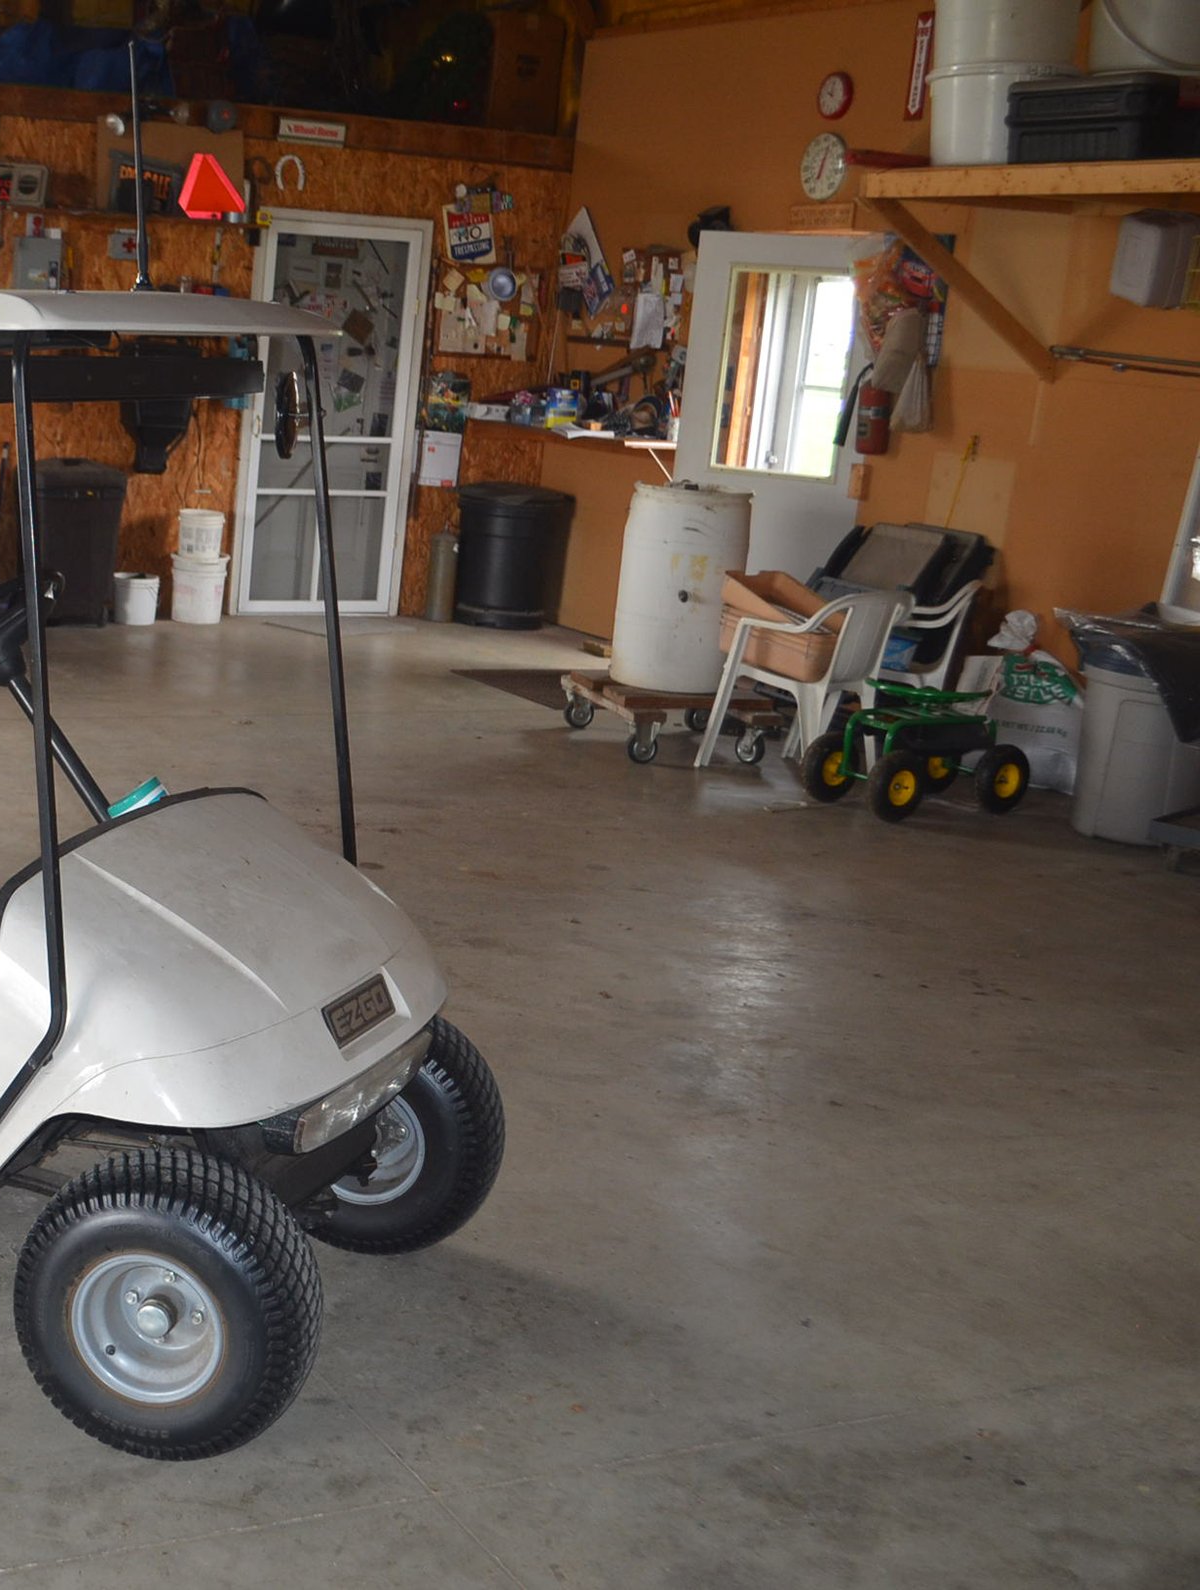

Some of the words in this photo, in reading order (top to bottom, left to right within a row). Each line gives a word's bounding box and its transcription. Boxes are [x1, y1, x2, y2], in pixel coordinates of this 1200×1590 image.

[457, 226, 482, 242] NO
[453, 241, 491, 257] TRESPASSING
[331, 986, 390, 1039] EZGO
